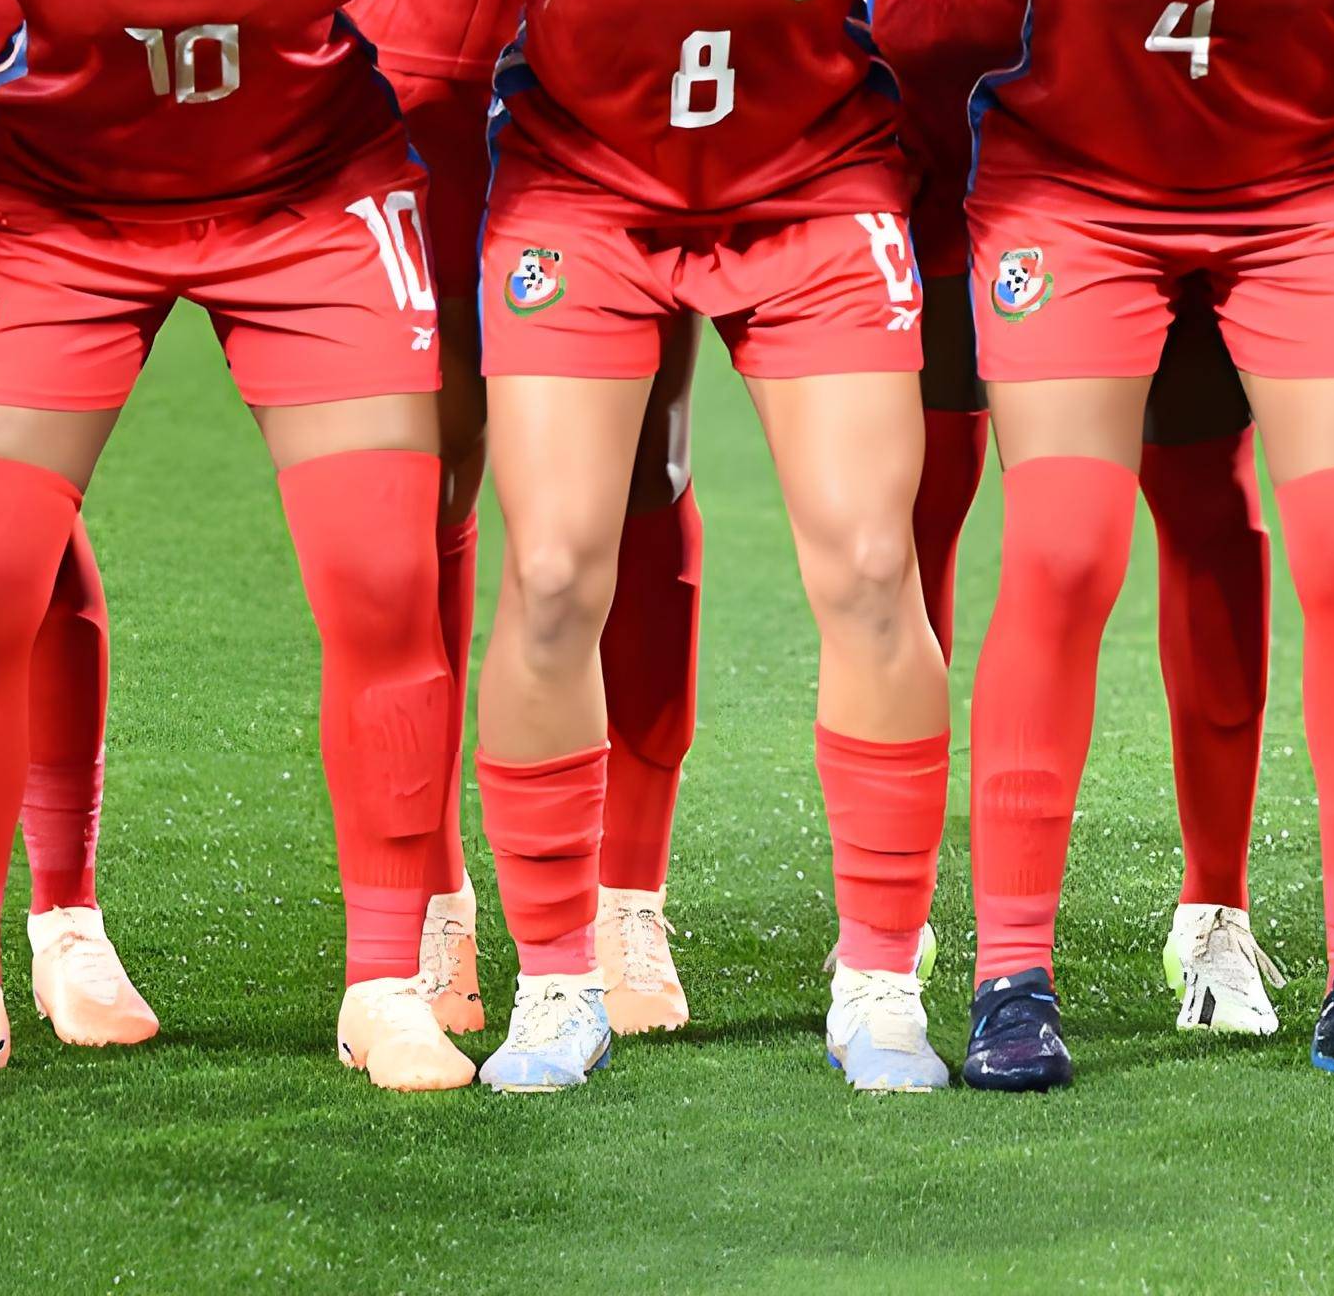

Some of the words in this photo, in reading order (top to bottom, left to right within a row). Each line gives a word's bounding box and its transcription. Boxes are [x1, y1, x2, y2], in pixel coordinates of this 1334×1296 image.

[123, 23, 240, 104] 10
[669, 29, 735, 128] 8
[345, 190, 436, 311] 10
